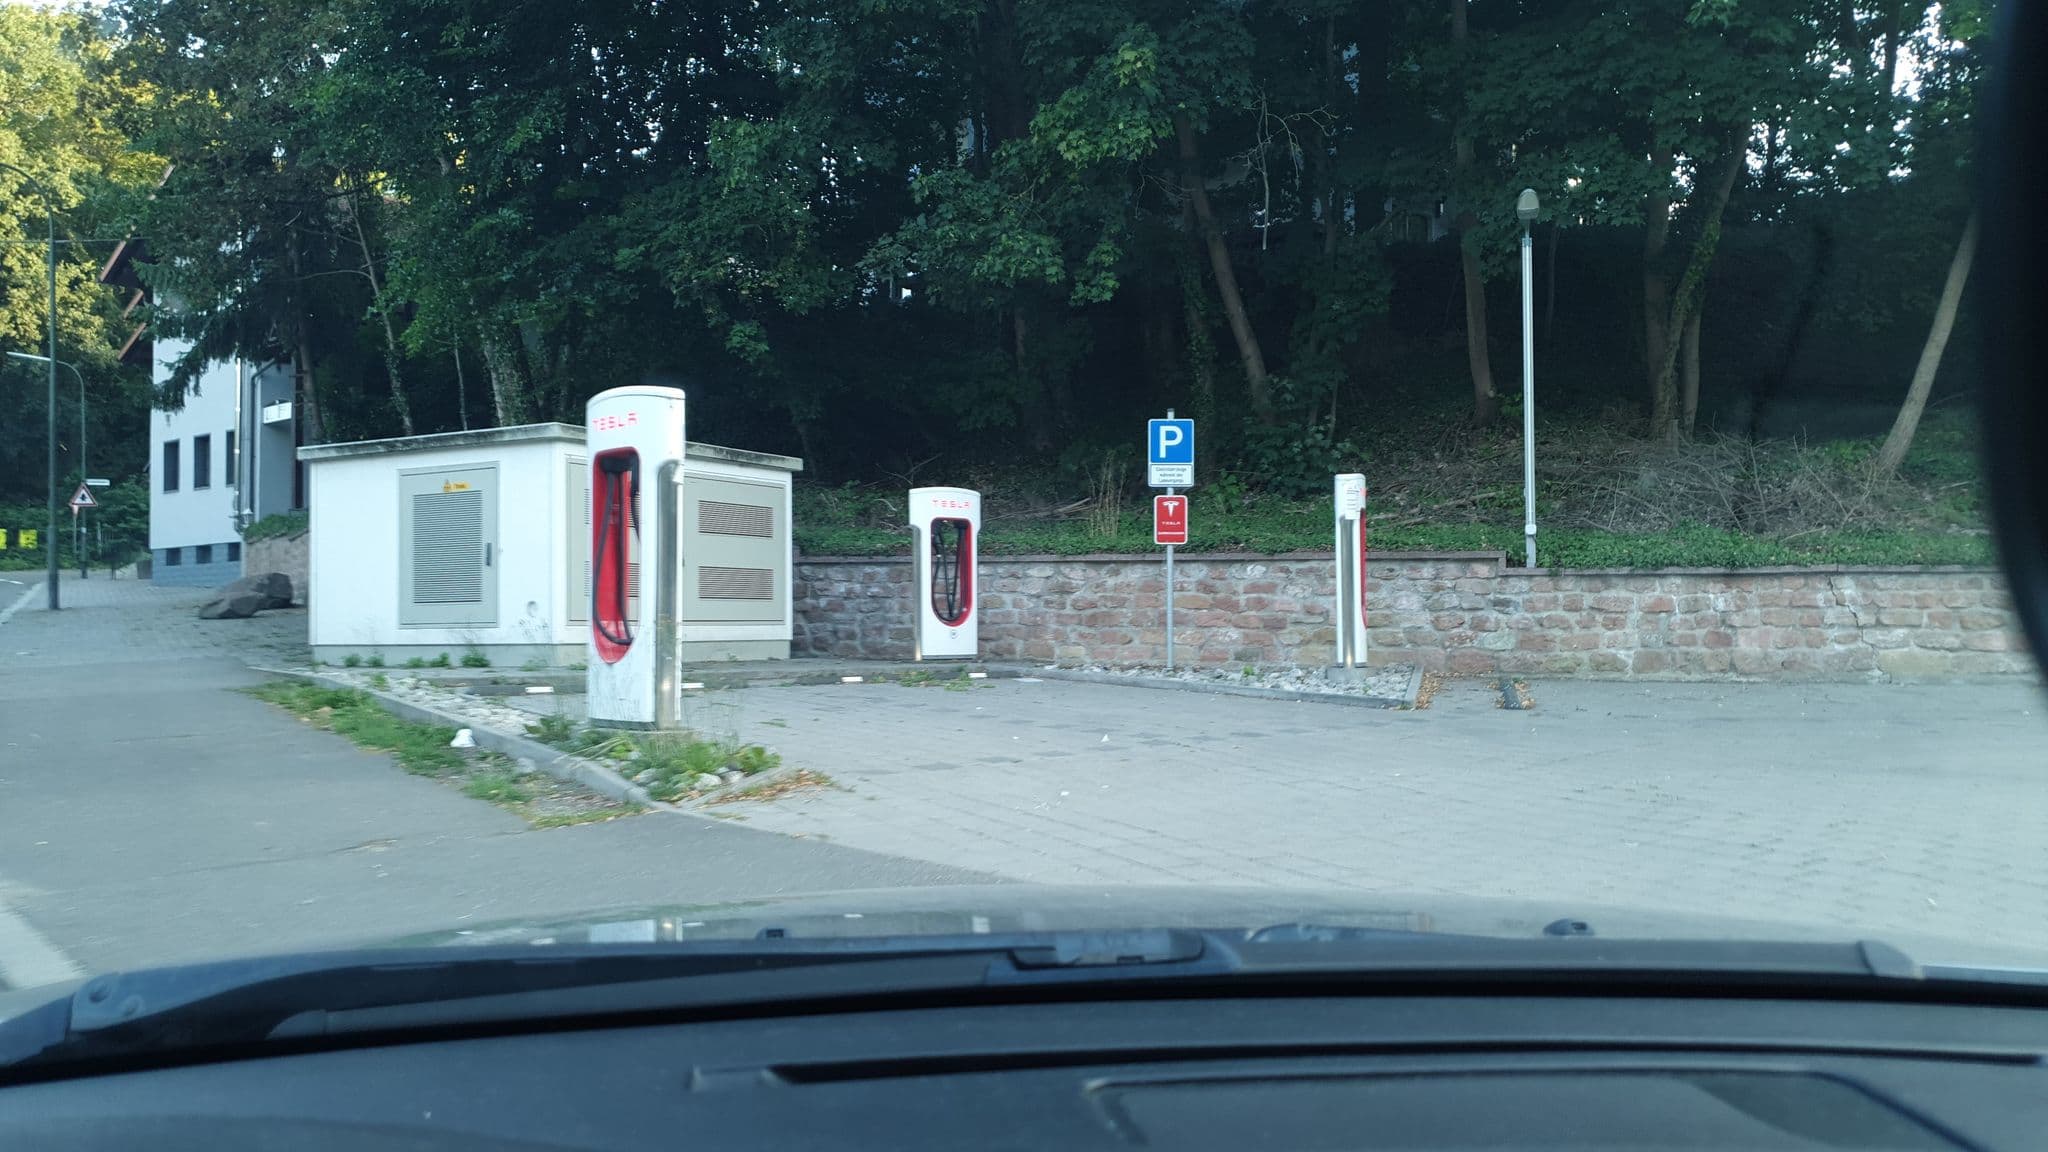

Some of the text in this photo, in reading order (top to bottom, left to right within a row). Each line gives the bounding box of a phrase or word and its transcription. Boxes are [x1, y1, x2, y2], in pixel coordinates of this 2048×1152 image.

[592, 412, 638, 432] TESLA
[1159, 425, 1183, 459] P
[932, 499, 971, 509] TESLA
